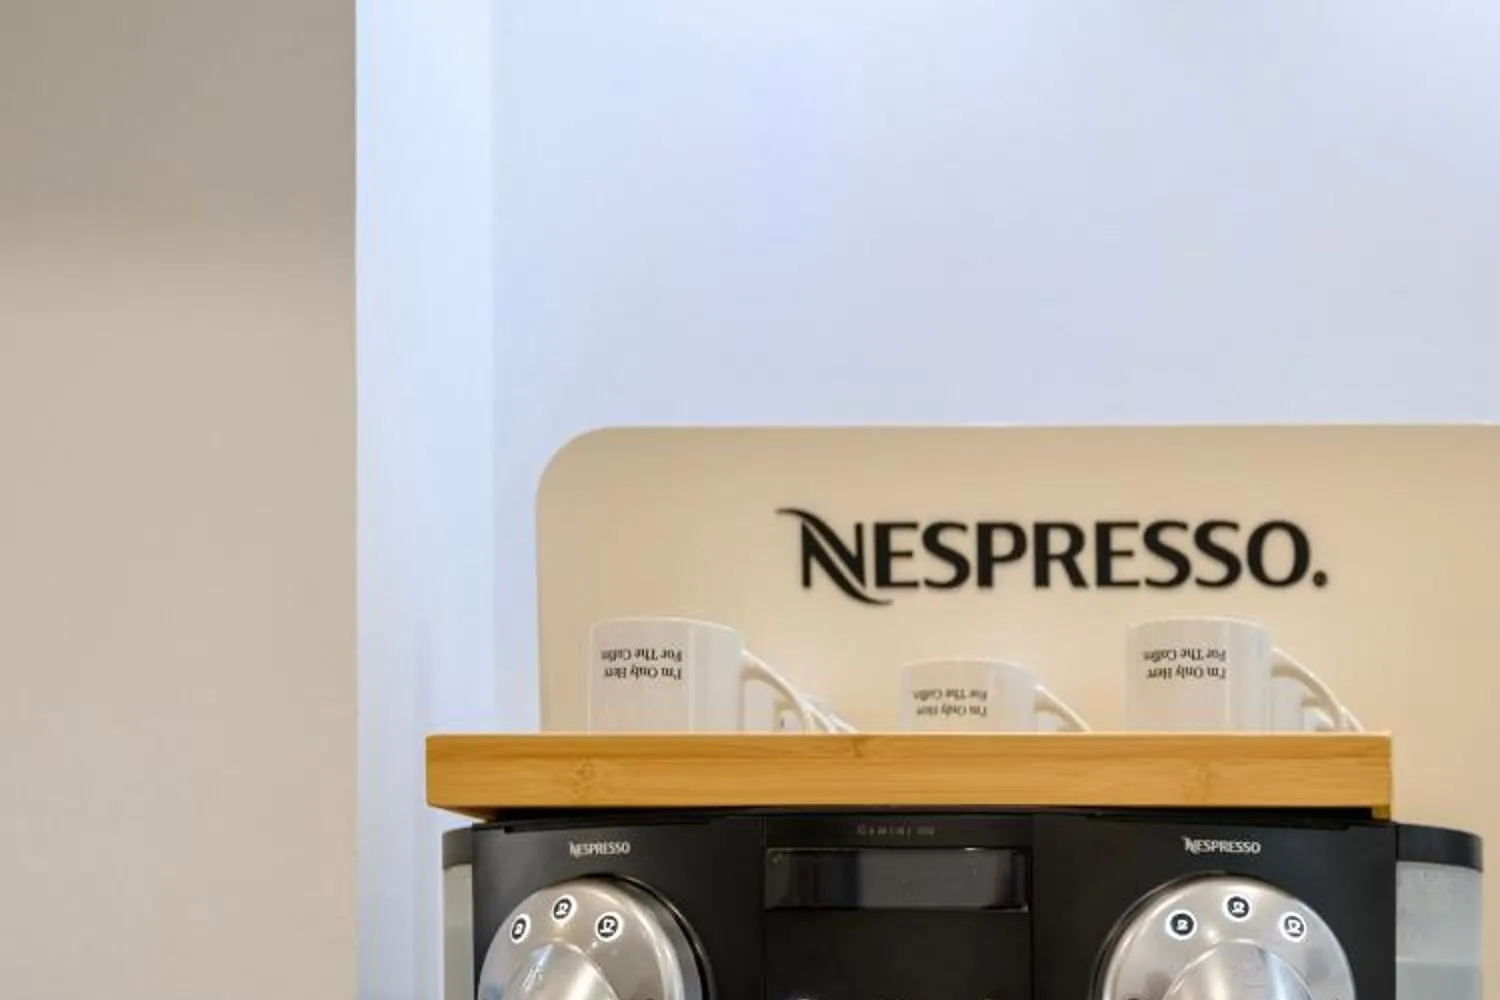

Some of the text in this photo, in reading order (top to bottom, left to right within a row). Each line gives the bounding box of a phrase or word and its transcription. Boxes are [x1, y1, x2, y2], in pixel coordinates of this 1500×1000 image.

[634, 648, 659, 661] The
[660, 648, 683, 662] For
[1180, 648, 1204, 661] The
[1206, 648, 1226, 661] For
[630, 664, 659, 679] Only
[1175, 664, 1205, 680] Only
[569, 840, 631, 859] NESPRESSO
[1181, 835, 1262, 855] NESPRESSO
